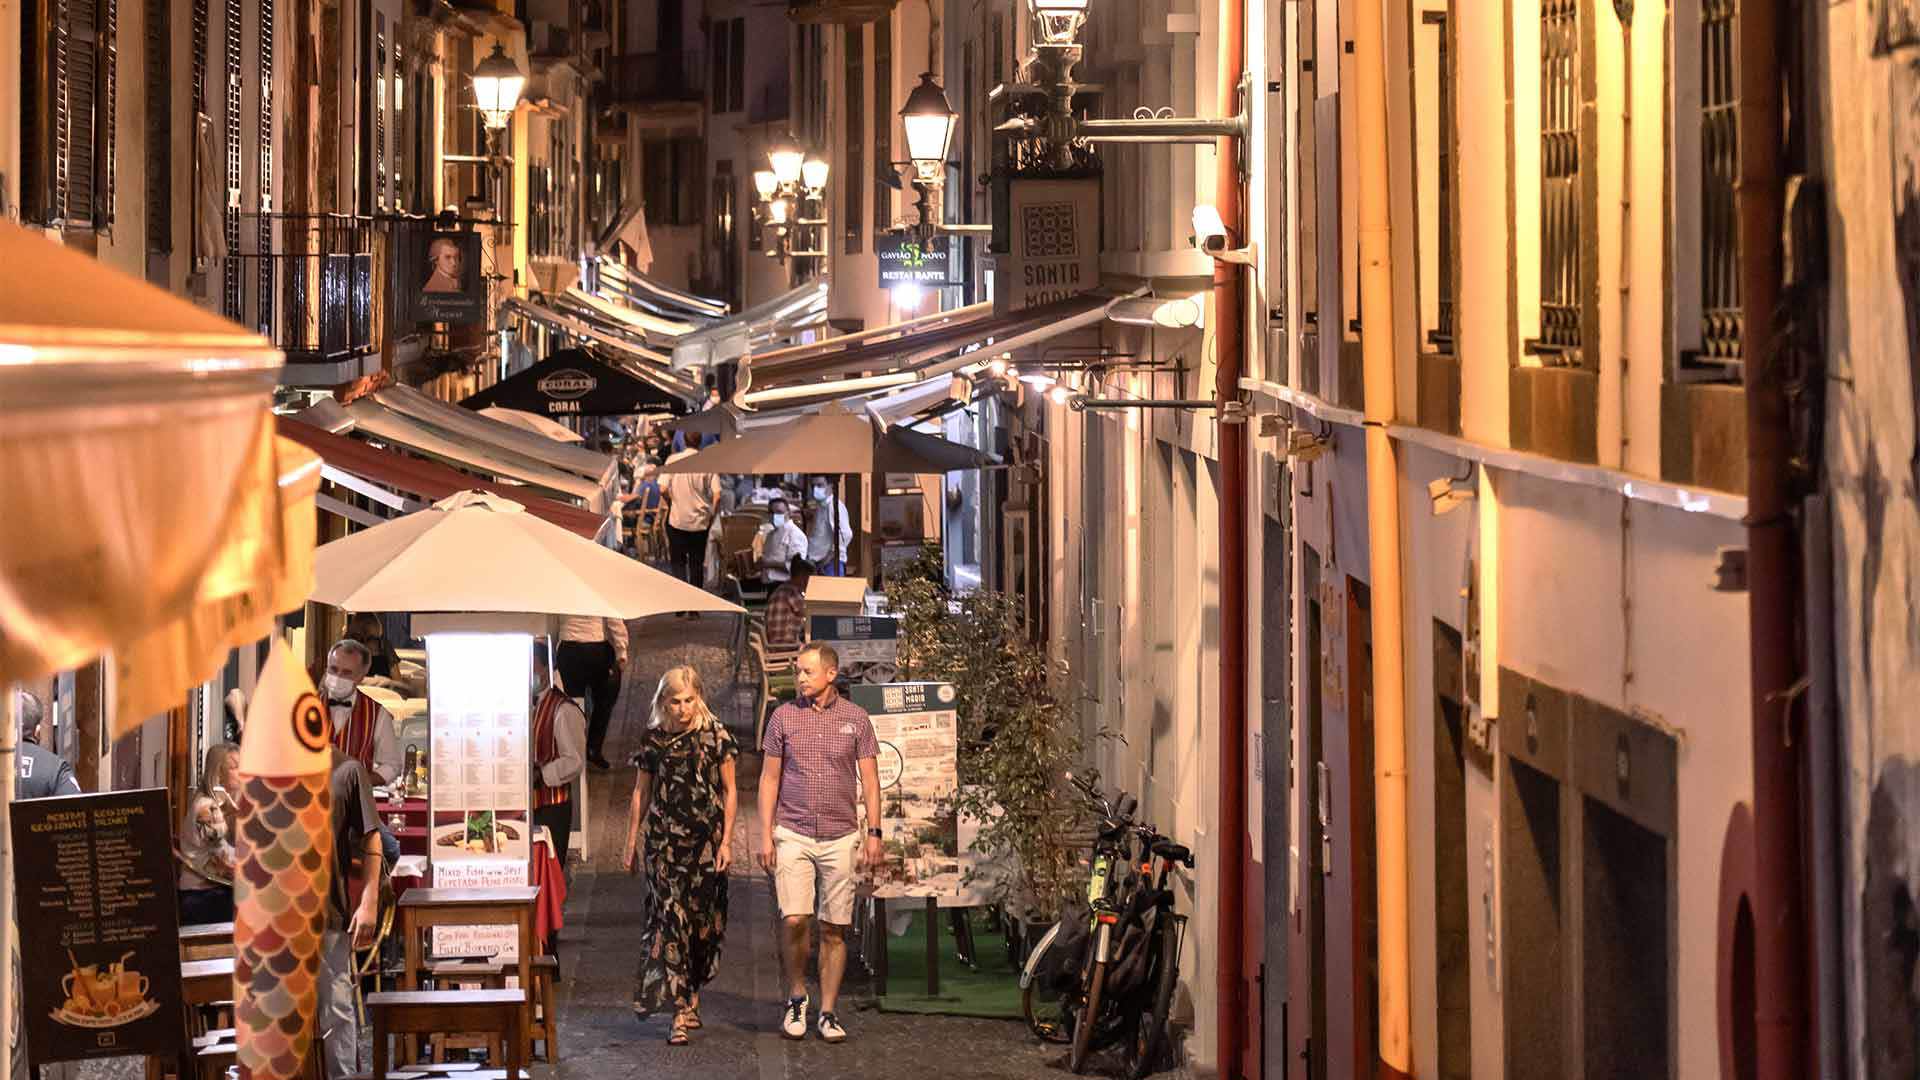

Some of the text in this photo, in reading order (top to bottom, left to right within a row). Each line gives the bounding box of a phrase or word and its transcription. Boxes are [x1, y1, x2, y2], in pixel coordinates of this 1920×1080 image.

[921, 251, 947, 260] NOVO
[1024, 263, 1080, 287] SANTA
[546, 380, 588, 390] CORAL
[549, 401, 581, 413] CORAL
